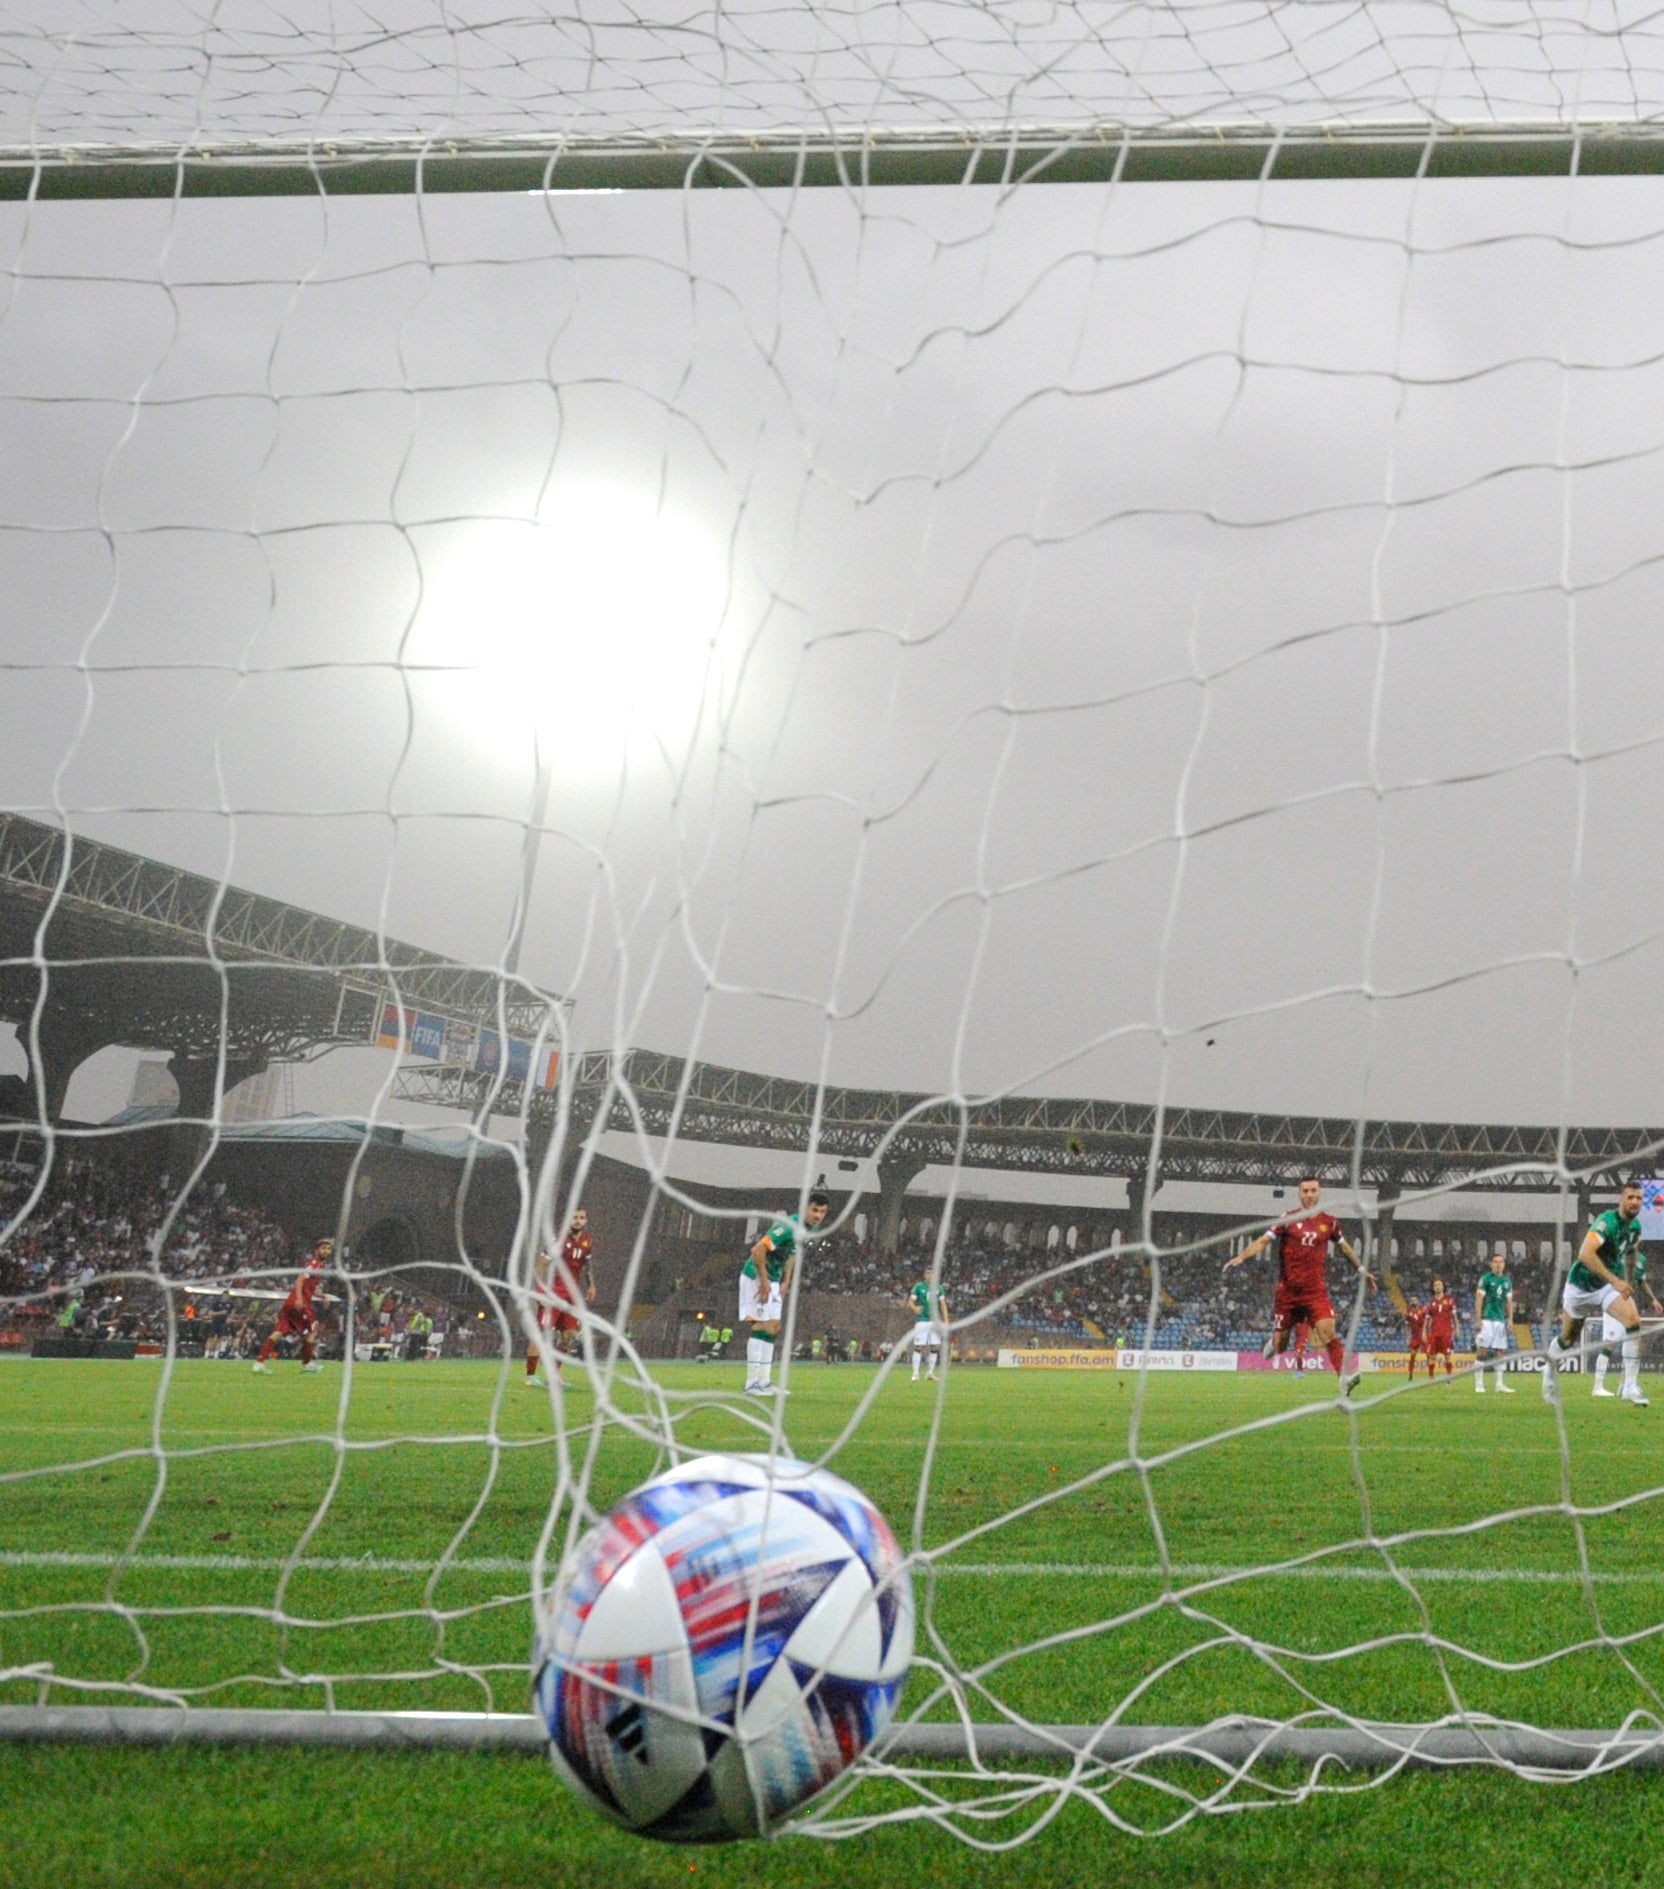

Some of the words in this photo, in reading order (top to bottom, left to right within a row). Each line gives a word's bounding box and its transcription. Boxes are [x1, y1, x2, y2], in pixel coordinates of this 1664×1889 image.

[414, 1026, 441, 1046] FIFA
[1301, 1231, 1318, 1247] 22
[572, 1248, 582, 1259] 11
[1496, 1285, 1503, 1296] 6
[1011, 1354, 1114, 1365] fanshop.ffa.am
